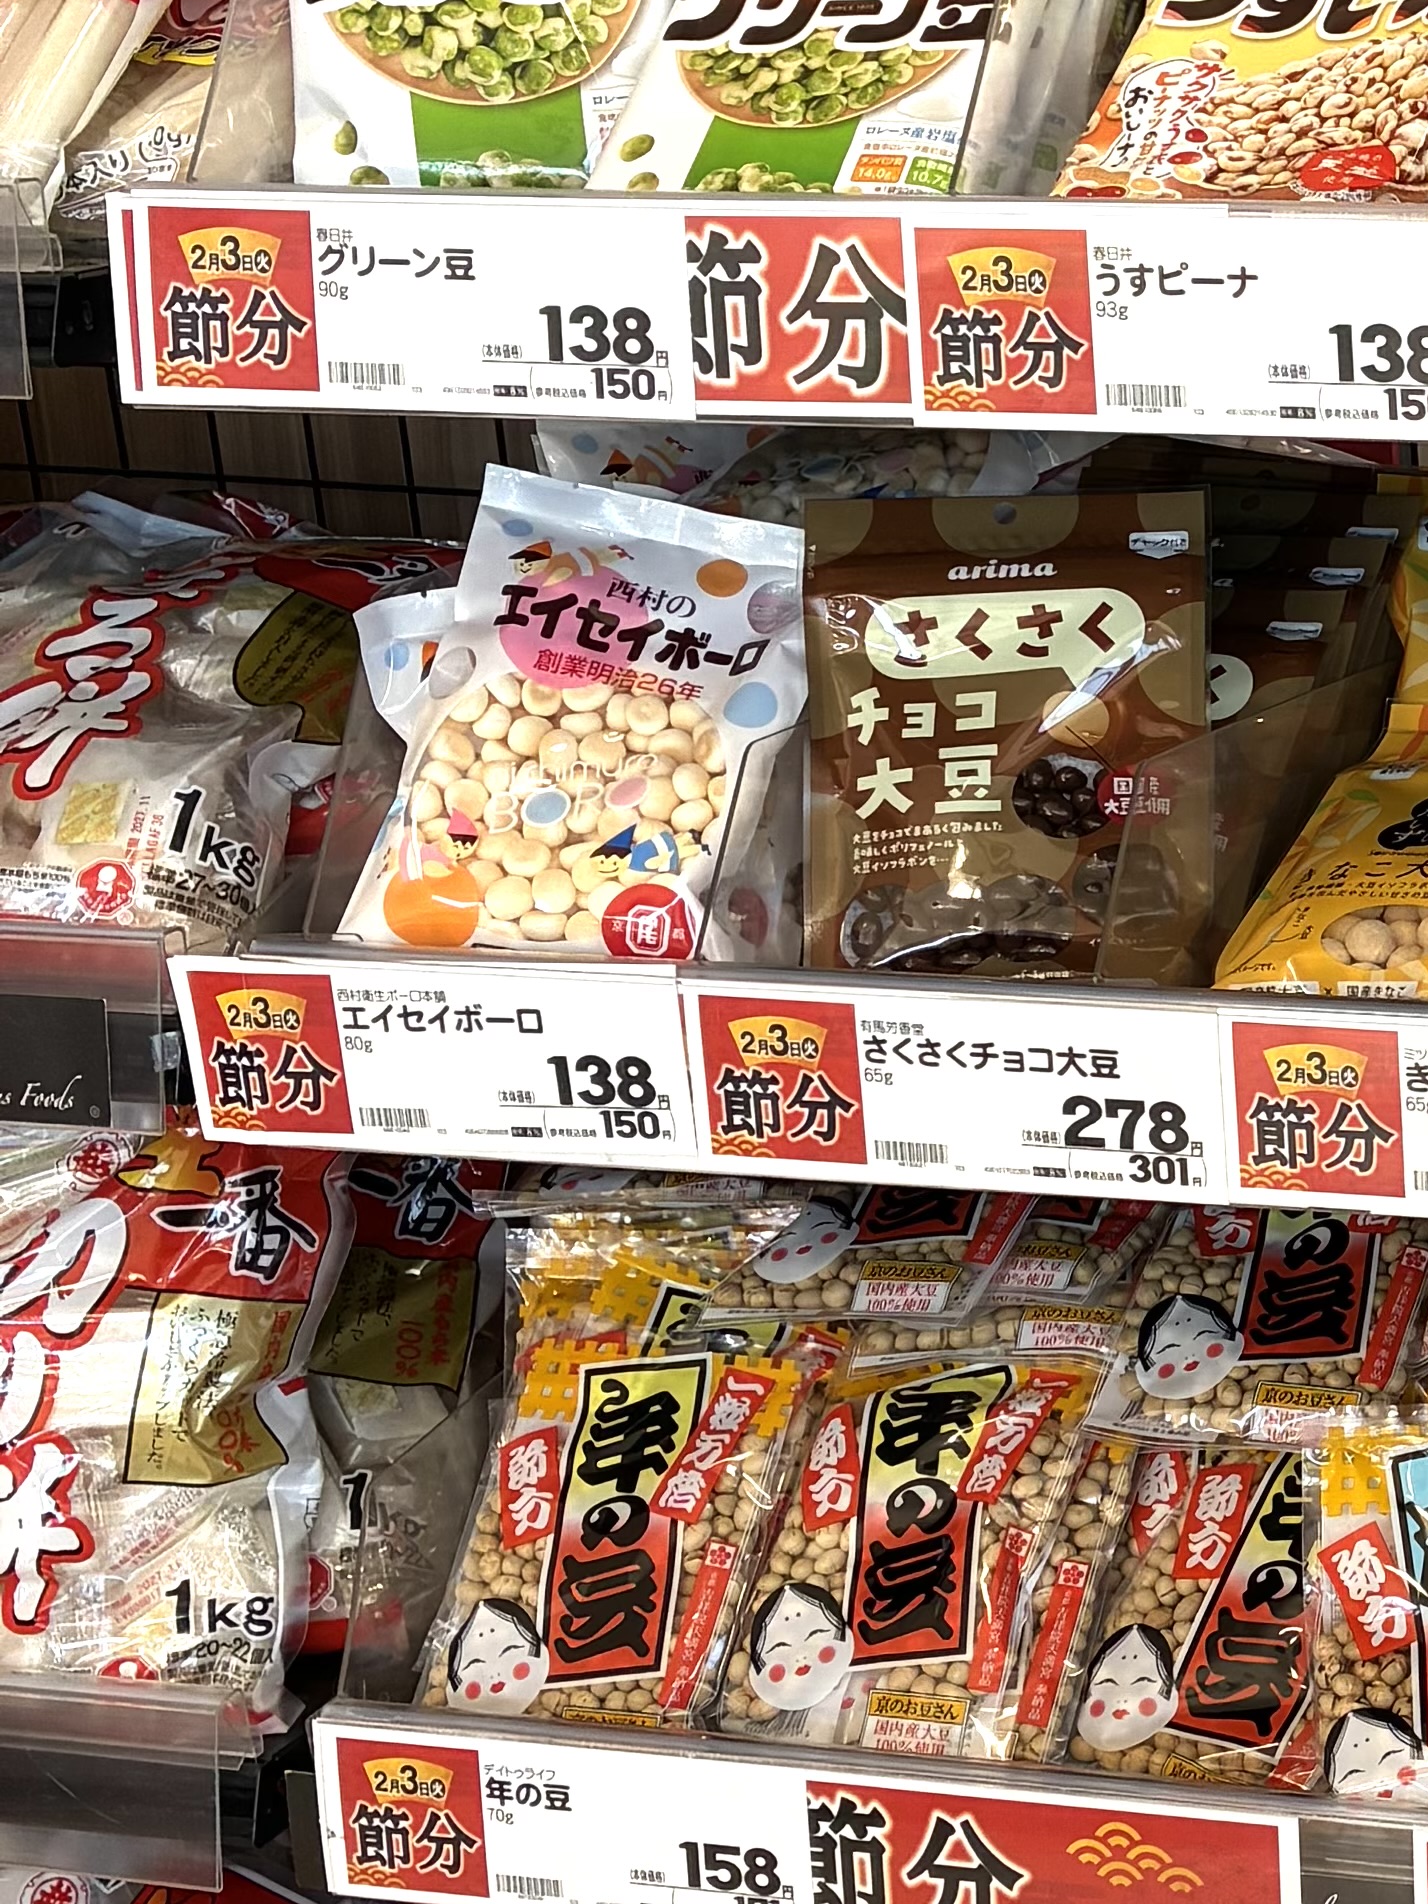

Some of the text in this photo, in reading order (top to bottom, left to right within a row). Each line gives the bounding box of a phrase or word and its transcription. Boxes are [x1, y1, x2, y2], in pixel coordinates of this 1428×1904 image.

[317, 230, 353, 243] 春日井
[1094, 246, 1132, 261] 春日井
[317, 246, 476, 280] グリーン豆
[1095, 265, 1258, 298] うすピーナ
[318, 281, 349, 300] 90g
[689, 229, 908, 390] 節分
[164, 286, 306, 367] 節分
[1096, 301, 1129, 322] 93g
[932, 306, 1086, 390] 節分
[947, 558, 1058, 582] arima
[608, 575, 697, 618] 西村の
[493, 582, 770, 676] エイセイボーロ
[890, 601, 1118, 667] さくさく
[533, 648, 703, 700] 創業明治26年
[846, 687, 999, 745] チョコ
[854, 744, 1002, 819] 大豆
[343, 1005, 543, 1035] エイセイボーロ
[344, 1037, 373, 1054] 80g
[863, 1035, 1121, 1081] さくさくチョコ大豆
[209, 1037, 338, 1114] 節分
[864, 1068, 894, 1086] 65g
[715, 1066, 858, 1142] 節分
[1249, 1095, 1396, 1174] 節分
[873, 1696, 961, 1722] 京のお豆さん
[873, 1719, 952, 1742] 国内産大豆
[486, 1777, 571, 1815] 年の豆
[487, 1808, 515, 1826] 70g
[351, 1802, 480, 1876] 節分
